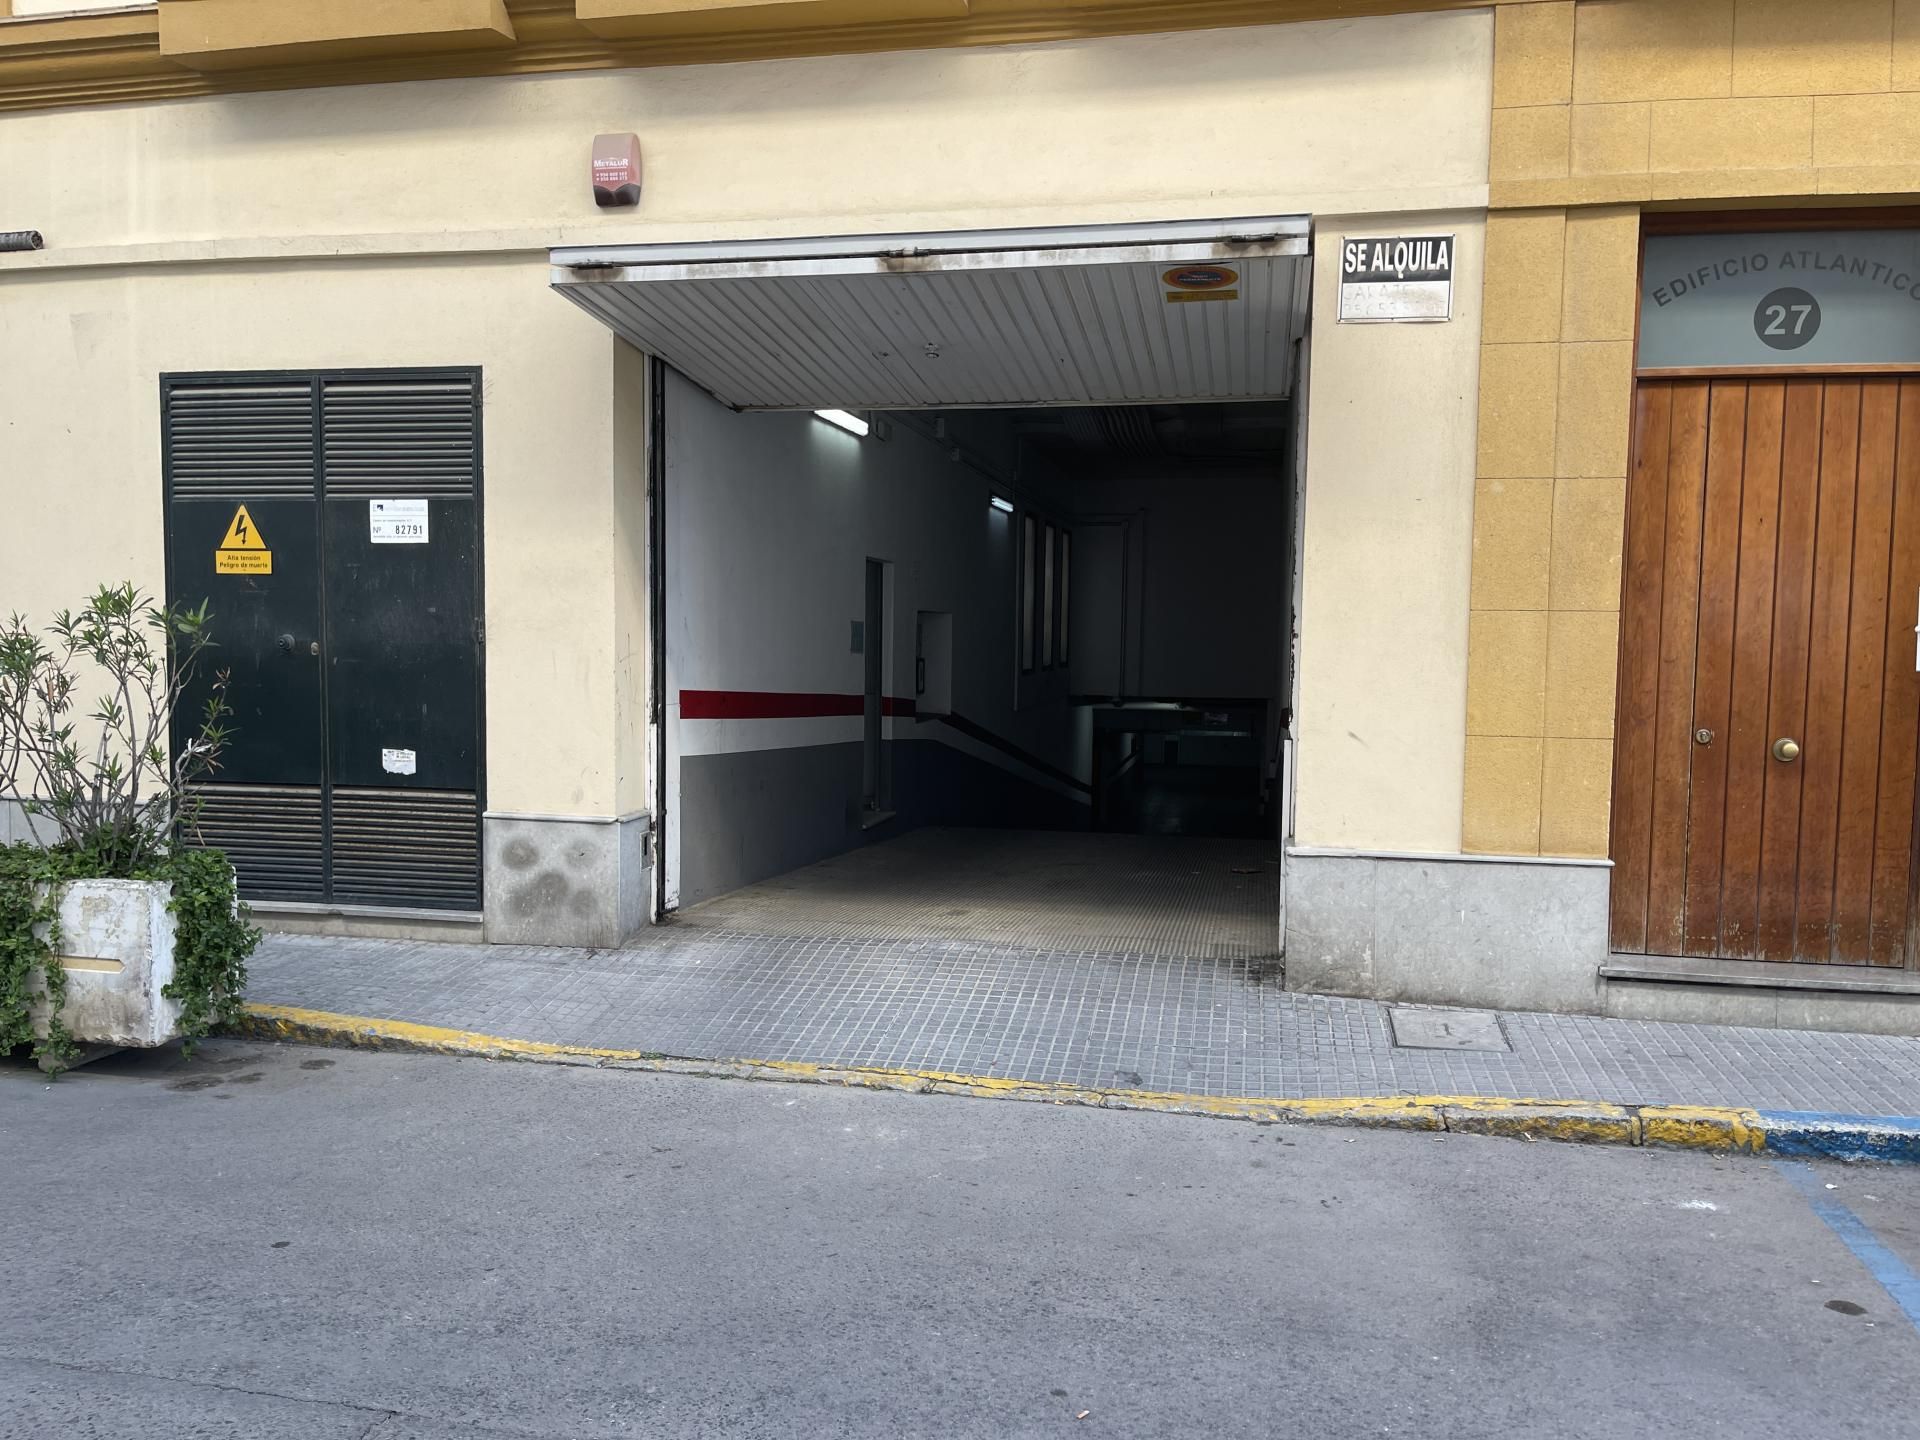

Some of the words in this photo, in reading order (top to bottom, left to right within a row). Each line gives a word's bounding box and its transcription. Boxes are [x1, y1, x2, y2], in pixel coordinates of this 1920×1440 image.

[1345, 243, 1368, 273] SE
[1371, 241, 1449, 279] ALQUILA
[1652, 253, 1769, 307] EDIFICIO
[1779, 251, 1920, 301] ATLANTICO
[1764, 304, 1812, 336] 27
[395, 525, 423, 535] 82791
